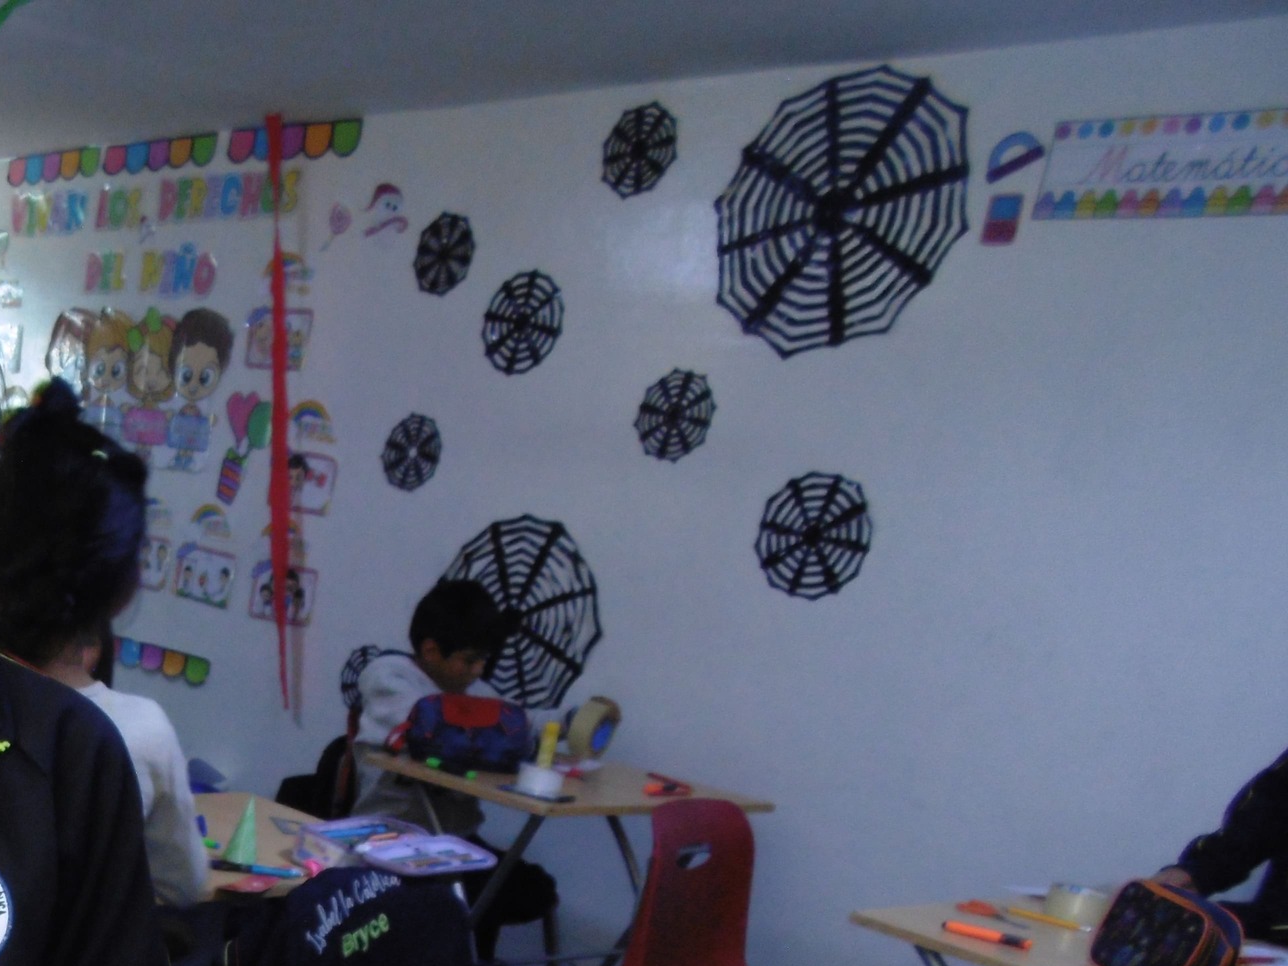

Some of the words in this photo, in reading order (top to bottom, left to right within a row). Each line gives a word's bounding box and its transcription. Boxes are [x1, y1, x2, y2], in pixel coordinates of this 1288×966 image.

[95, 187, 142, 231] LOS
[158, 168, 302, 222] DERECHOS
[84, 249, 125, 295] DEL
[139, 242, 217, 299] NIÑO
